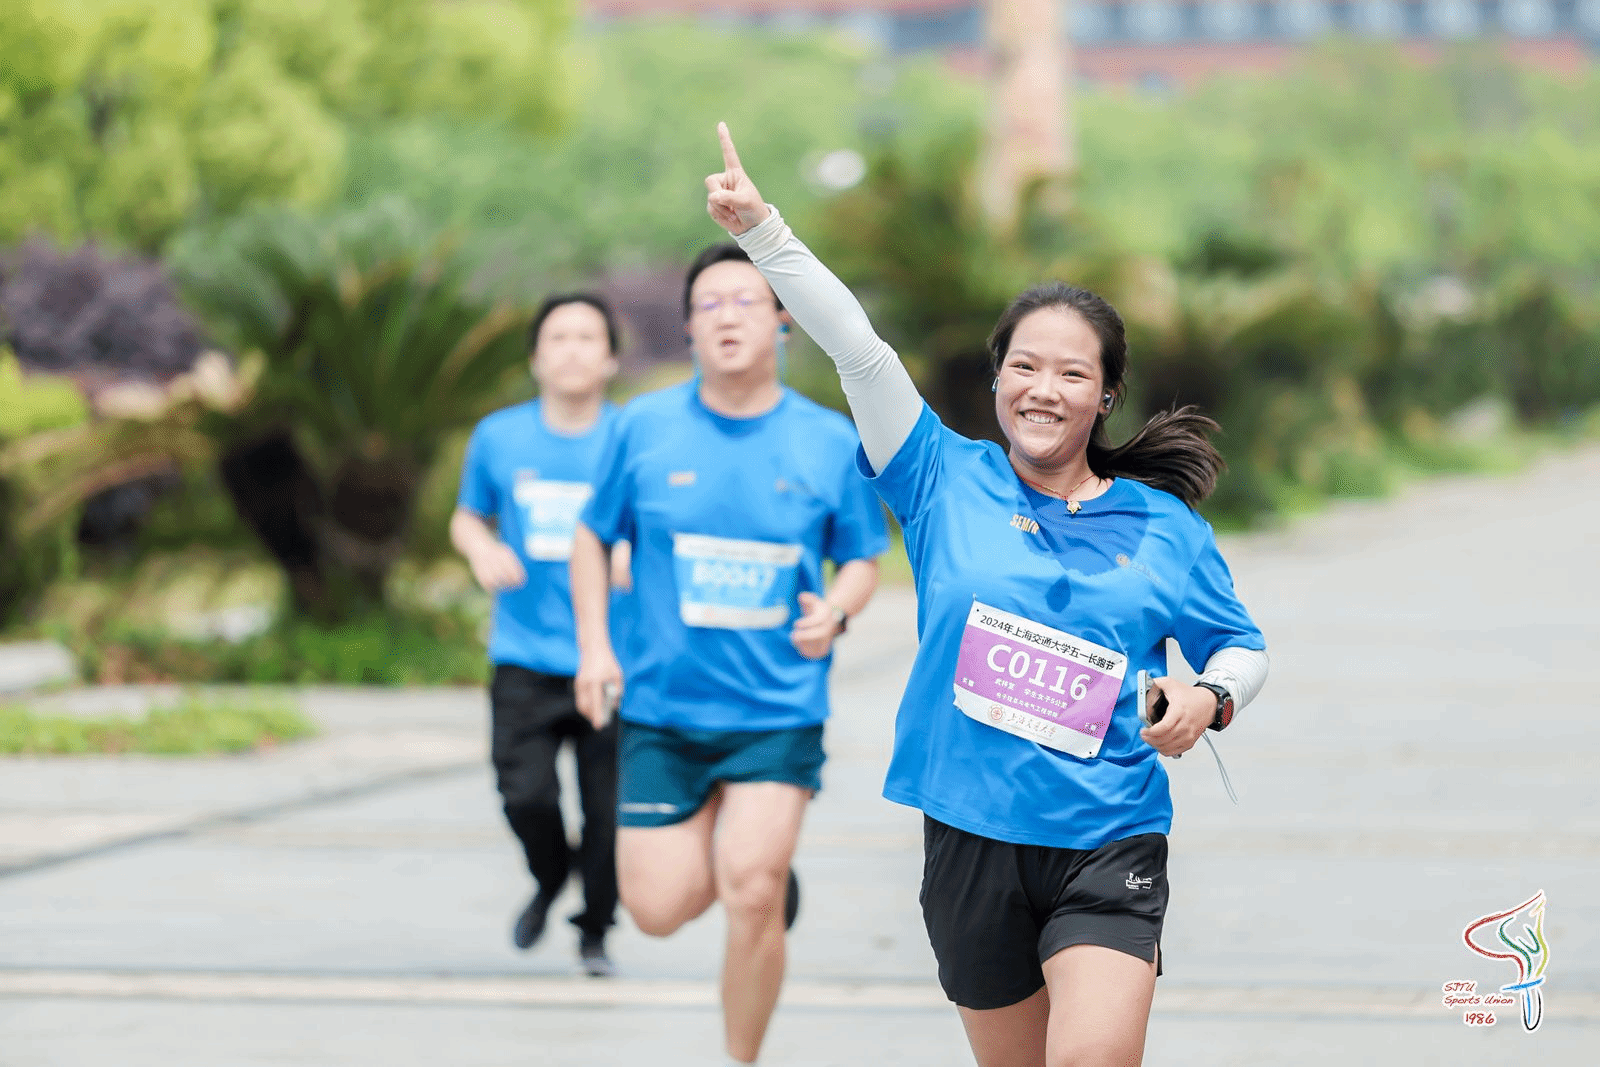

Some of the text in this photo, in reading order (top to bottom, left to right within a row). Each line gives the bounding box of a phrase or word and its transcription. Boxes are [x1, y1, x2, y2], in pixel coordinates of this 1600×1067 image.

[980, 615, 1116, 671] 2024年上海交通大学五一长跑节
[986, 644, 1092, 701] C0116
